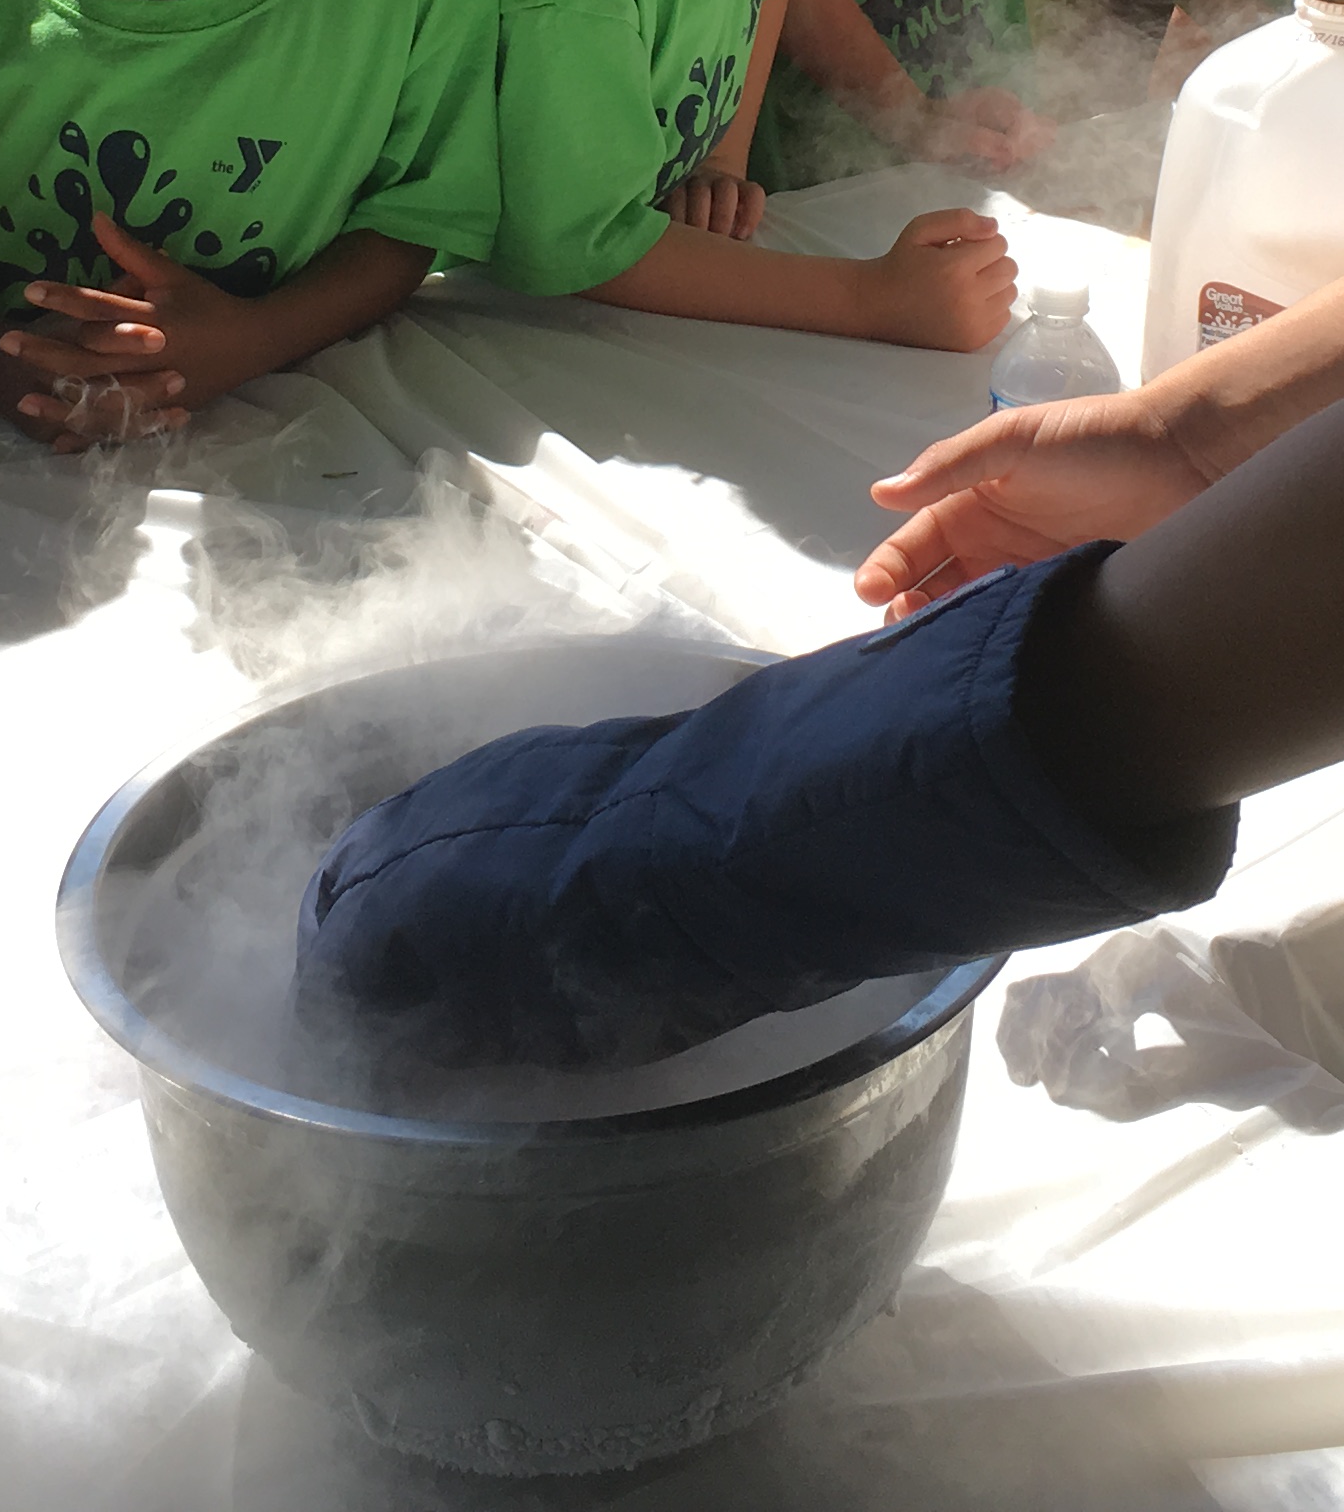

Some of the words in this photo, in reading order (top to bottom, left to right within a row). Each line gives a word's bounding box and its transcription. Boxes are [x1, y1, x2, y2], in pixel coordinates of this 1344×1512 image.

[211, 160, 234, 174] the
[229, 136, 283, 193] Y
[1205, 287, 1244, 306] Great
[1214, 300, 1244, 314] Value
